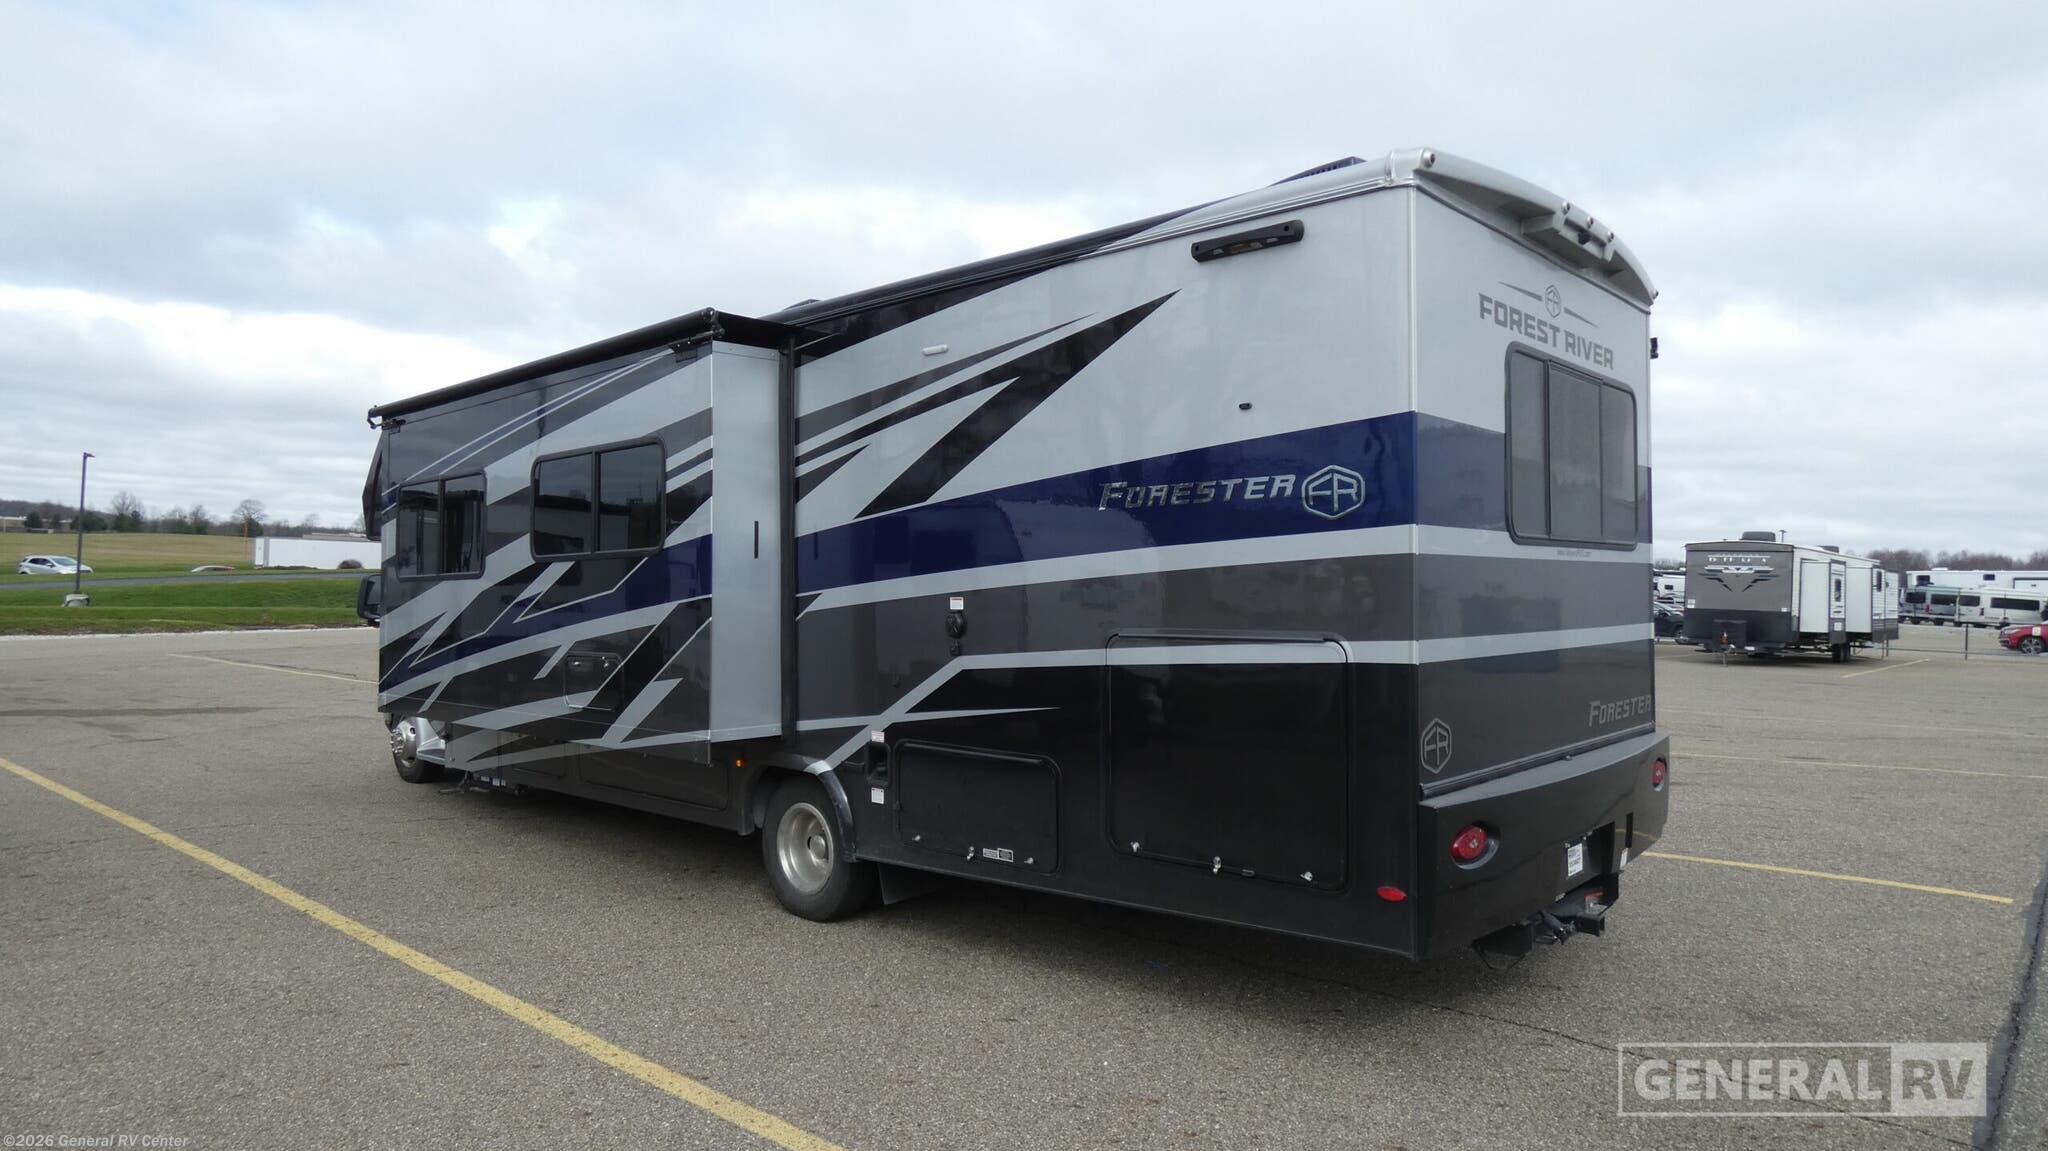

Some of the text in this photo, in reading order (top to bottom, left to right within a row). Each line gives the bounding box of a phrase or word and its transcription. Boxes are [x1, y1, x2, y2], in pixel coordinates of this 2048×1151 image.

[1478, 292, 1615, 370] FOREST RIVER
[1098, 473, 1297, 511] FORESTER
[1588, 694, 1652, 727] FORESTER
